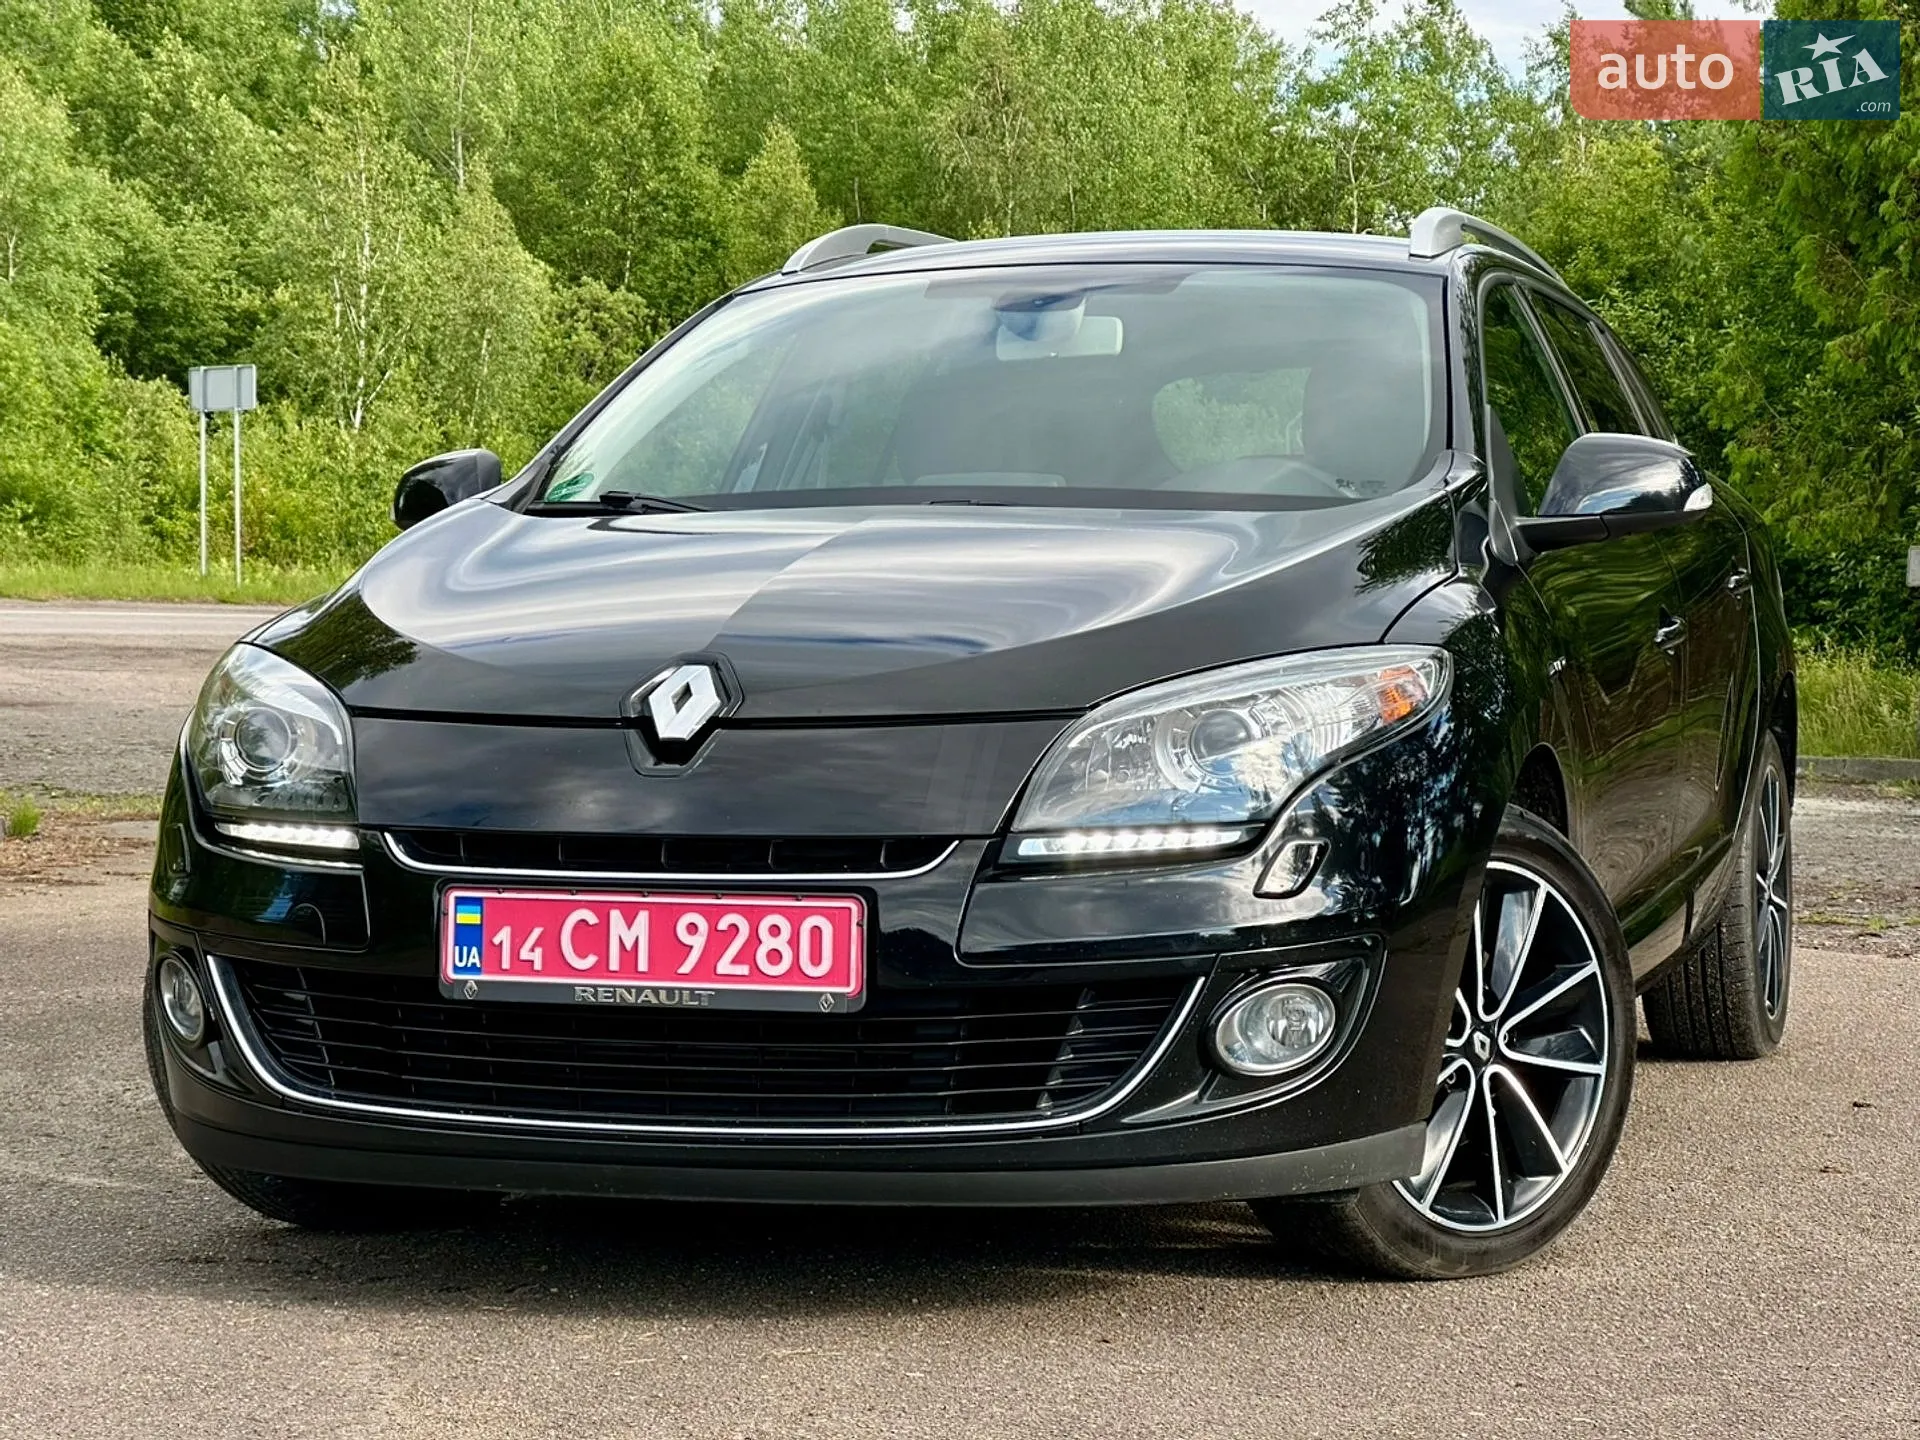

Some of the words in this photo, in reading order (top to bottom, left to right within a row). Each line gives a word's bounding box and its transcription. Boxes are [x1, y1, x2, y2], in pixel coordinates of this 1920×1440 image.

[491, 926, 543, 971] 14
[560, 908, 650, 973] CM
[675, 911, 833, 978] 9280
[454, 945, 481, 968] UA
[574, 986, 715, 1006] RENAULT
